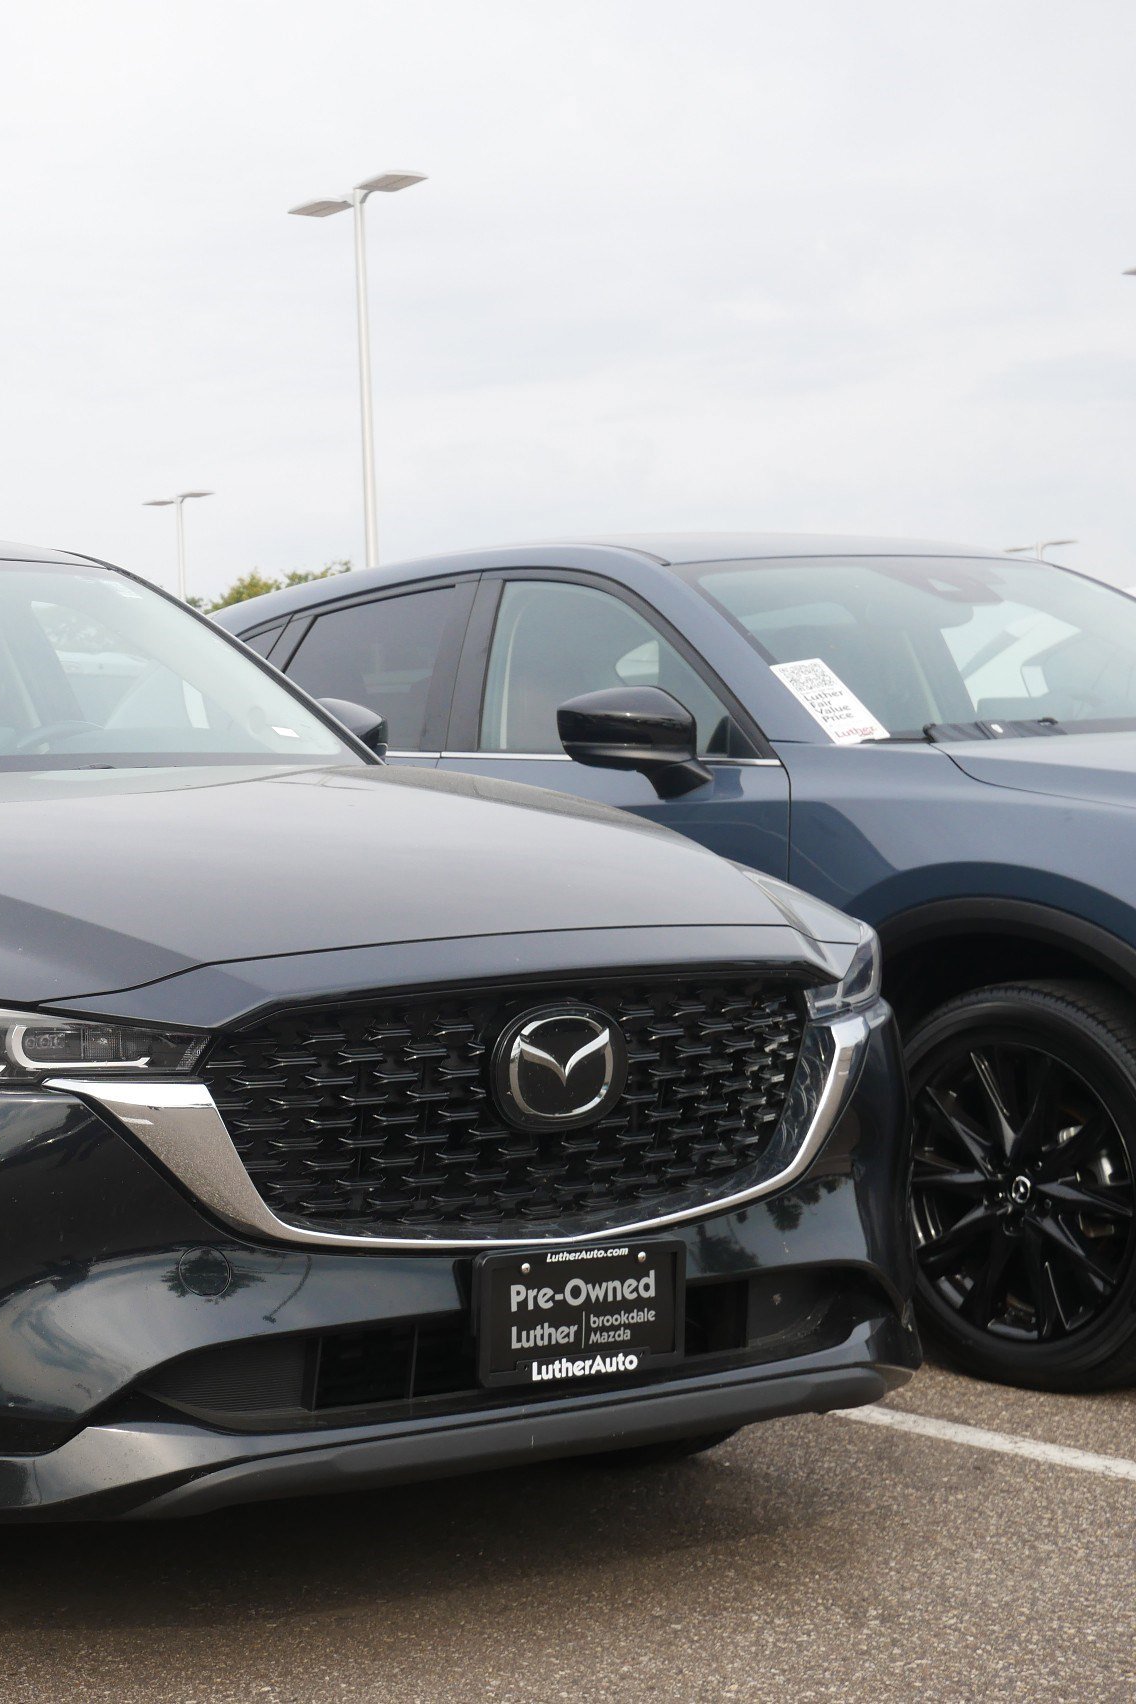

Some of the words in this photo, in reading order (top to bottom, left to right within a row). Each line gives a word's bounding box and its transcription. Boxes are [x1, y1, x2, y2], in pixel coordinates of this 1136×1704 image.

[804, 690, 843, 702] Luther
[810, 701, 832, 709] Fair
[815, 704, 851, 715] Value
[822, 712, 854, 723] Price
[546, 1247, 629, 1263] LutherAuto.com
[510, 1269, 656, 1313] Pre-Owned
[590, 1307, 656, 1328] brookdale
[511, 1322, 578, 1350] Luther
[589, 1327, 631, 1345] Mazda
[531, 1352, 639, 1381] LutherAuto
